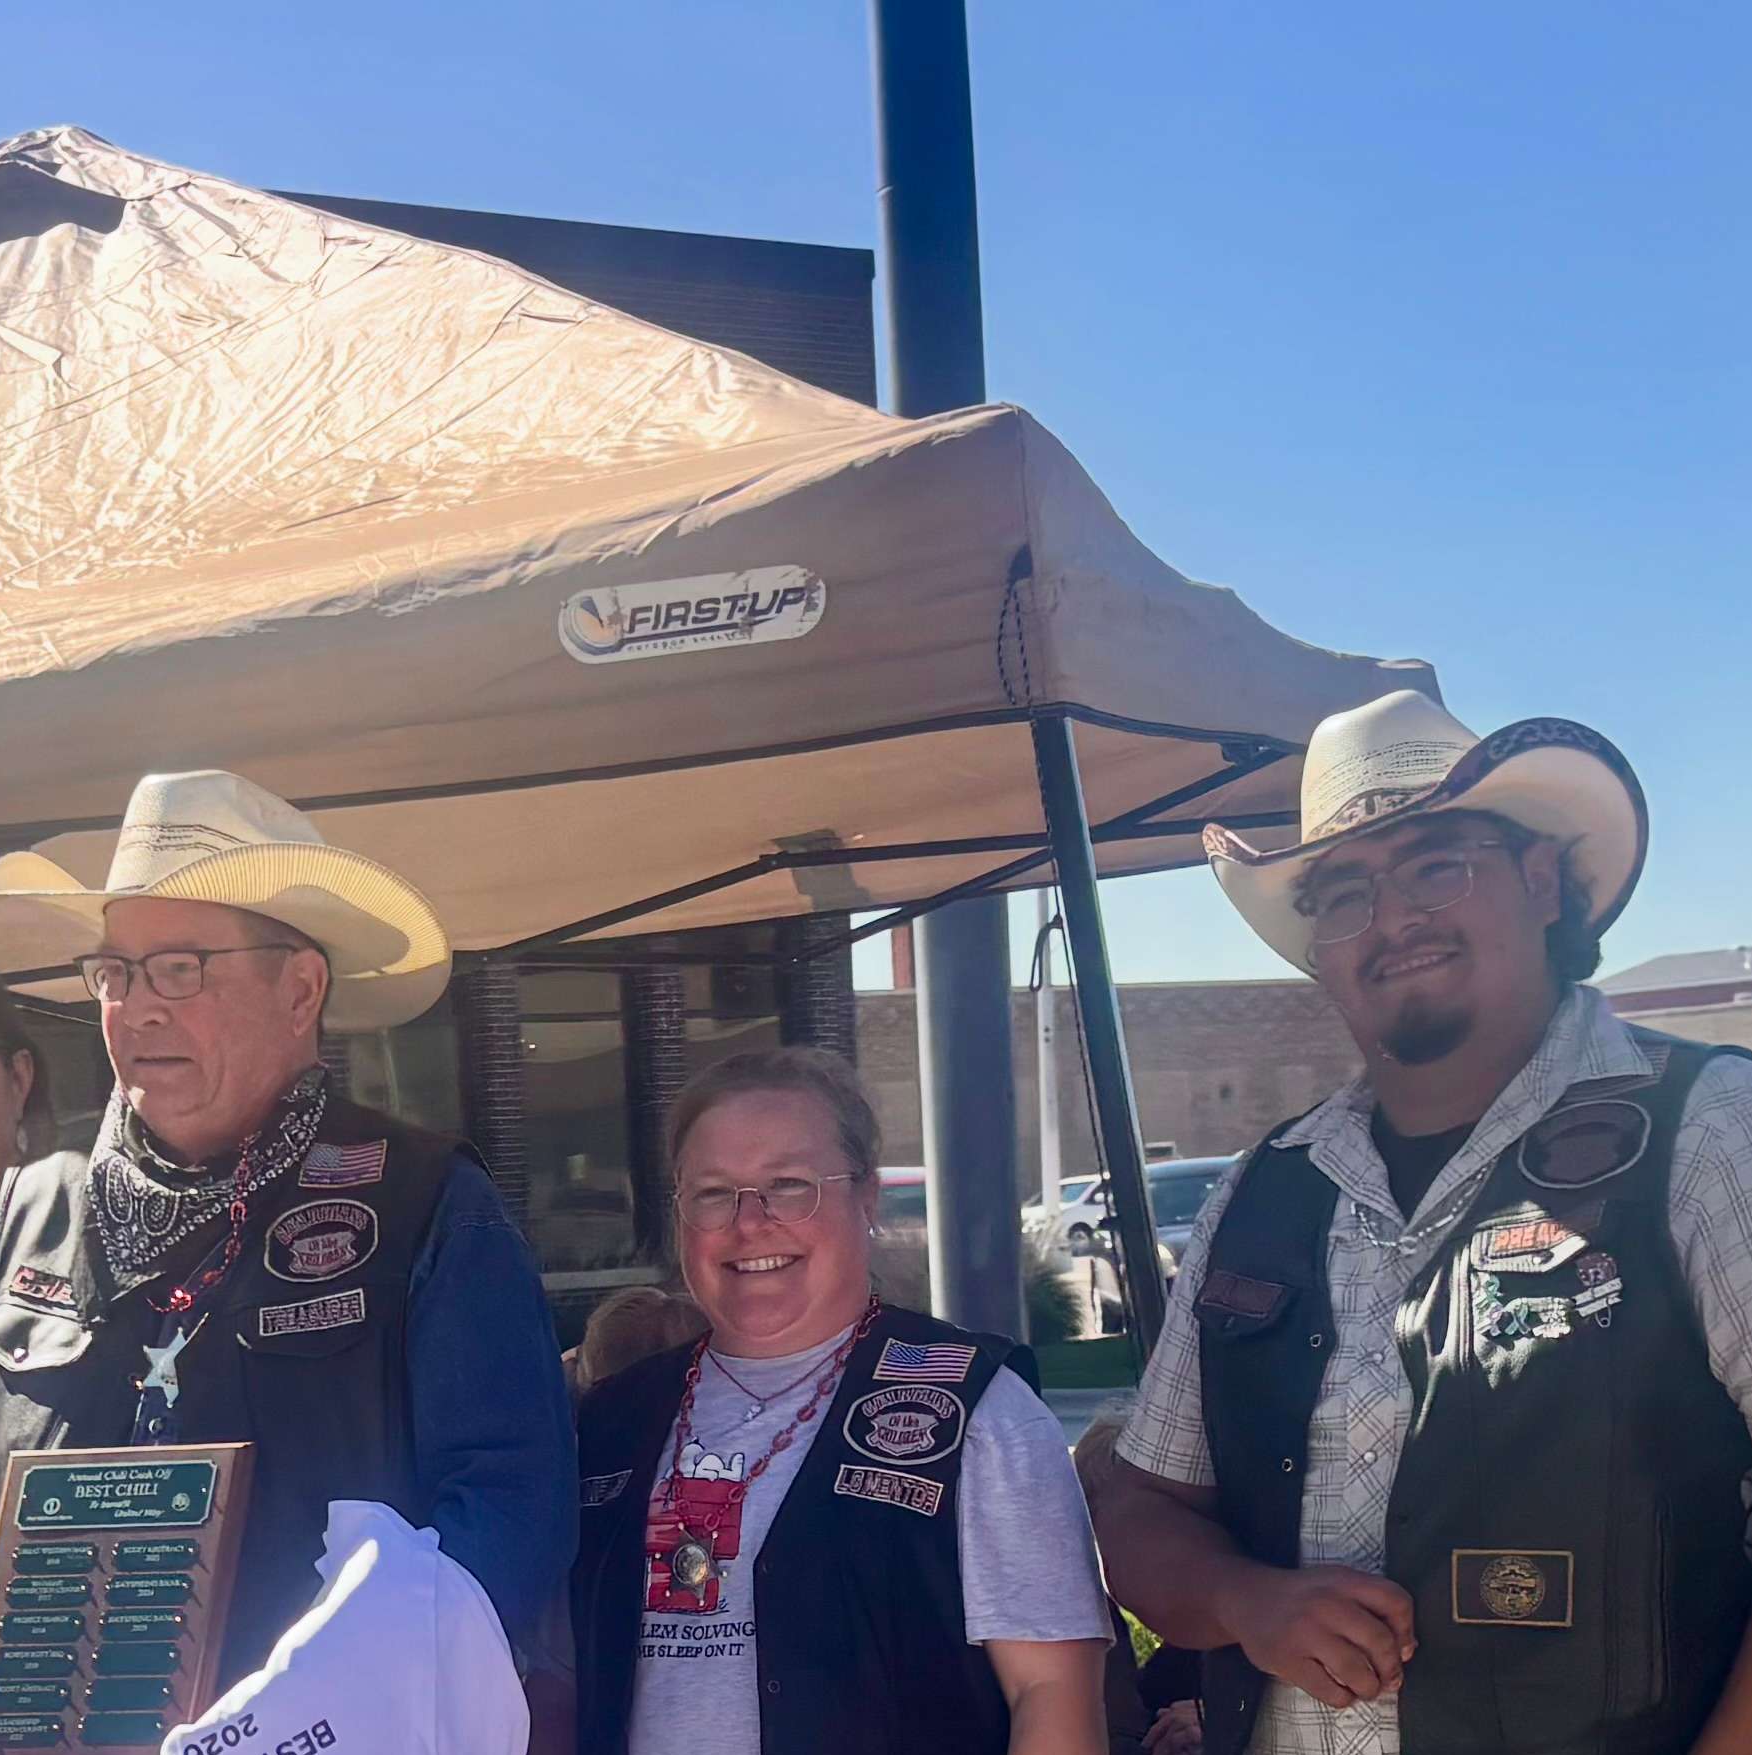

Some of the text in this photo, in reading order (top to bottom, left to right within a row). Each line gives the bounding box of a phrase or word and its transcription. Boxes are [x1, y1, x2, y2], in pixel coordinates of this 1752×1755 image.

[74, 1482, 159, 1499] BEST CHILI
[680, 1620, 757, 1641] SOLVING
[657, 1644, 703, 1658] SLEEP
[704, 1644, 726, 1658] ON
[729, 1643, 746, 1656] IT
